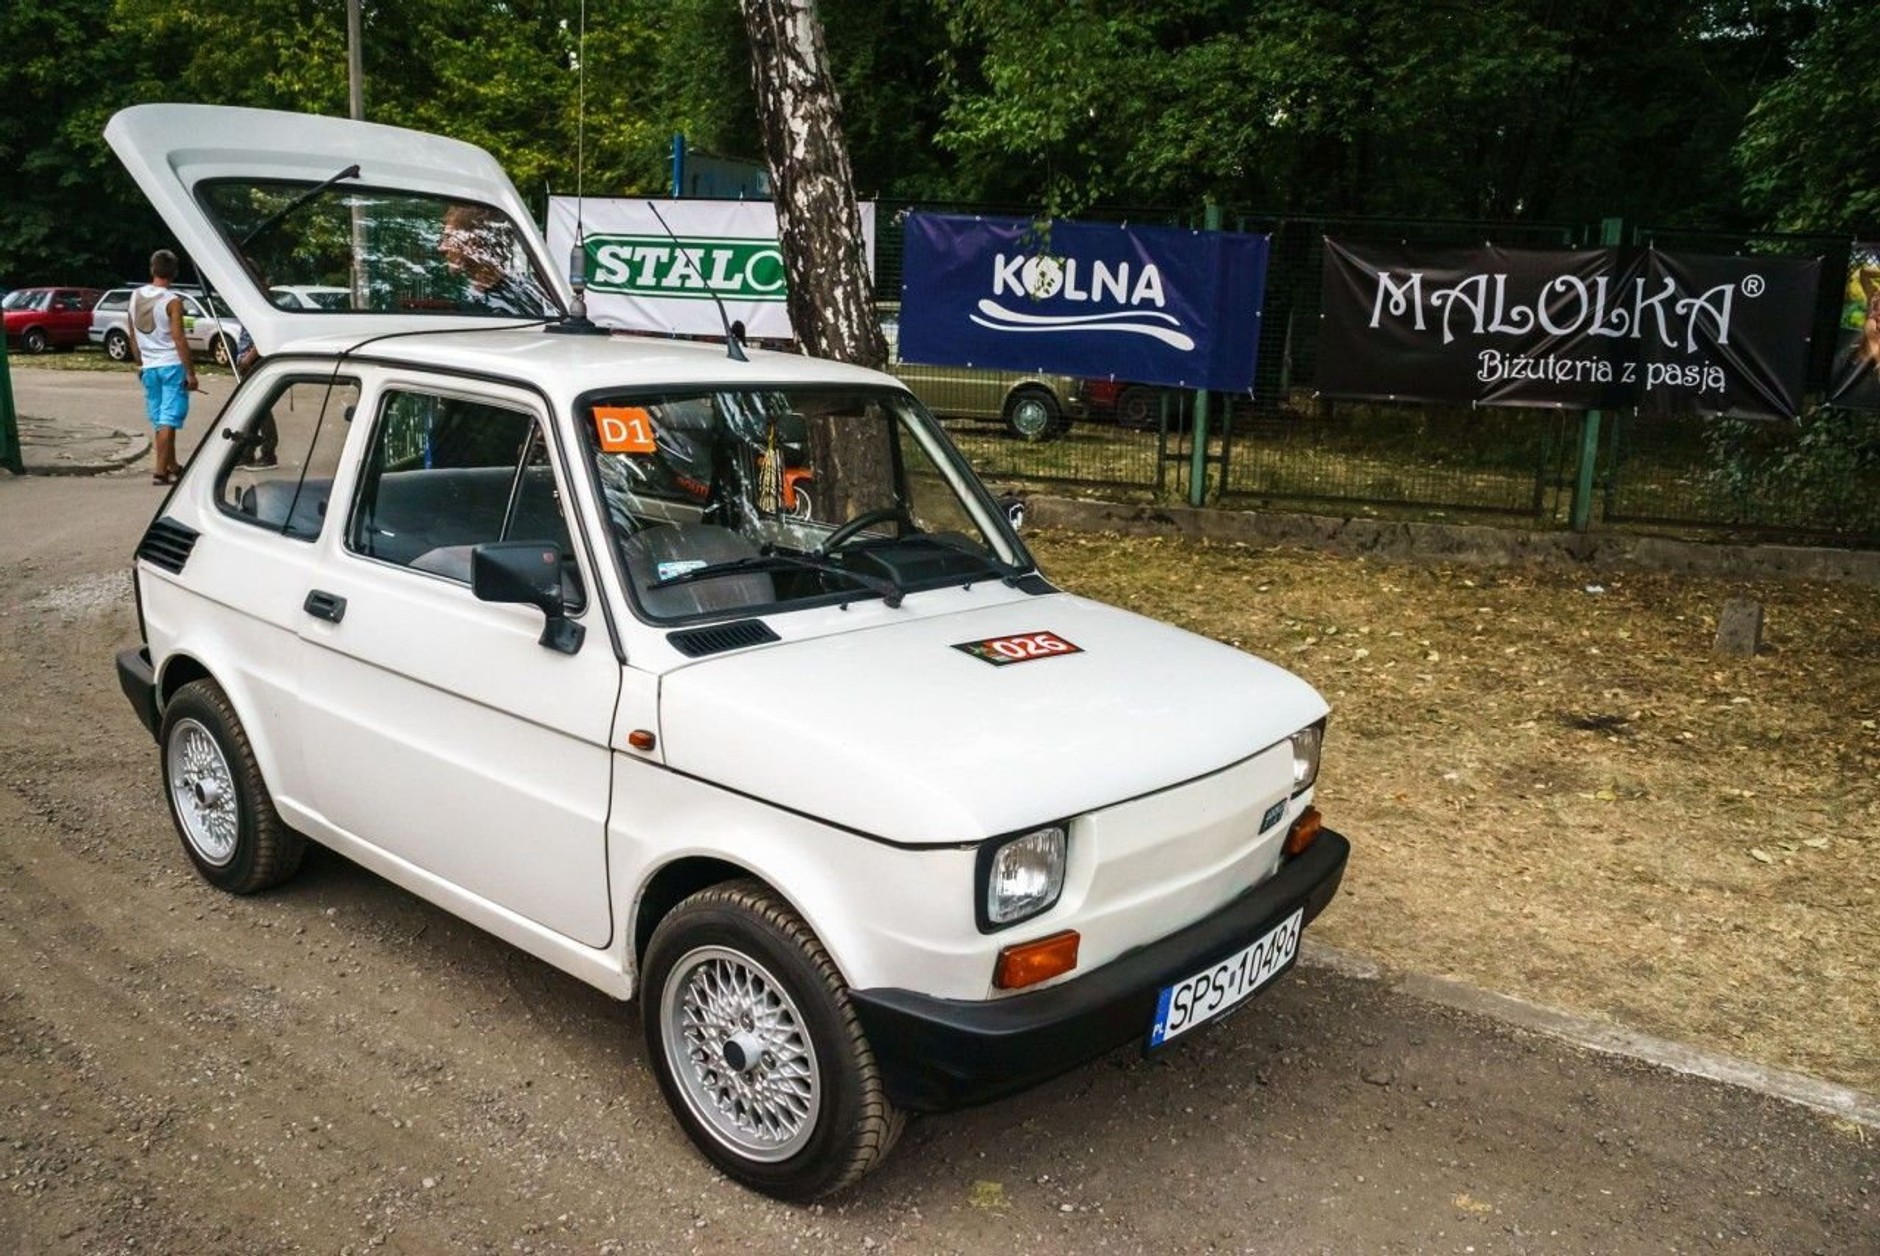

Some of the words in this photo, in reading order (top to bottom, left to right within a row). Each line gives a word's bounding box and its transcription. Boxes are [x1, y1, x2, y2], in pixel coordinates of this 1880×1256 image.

[594, 245, 788, 292] STALC
[993, 253, 1165, 308] KOLNA
[1621, 361, 1637, 384] z
[1646, 360, 1726, 395] pasją
[602, 418, 650, 444] D1
[992, 634, 1068, 659] 026
[1169, 965, 1229, 1031] SPS
[1237, 912, 1301, 995] 10496
[1152, 1021, 1164, 1038] PL
